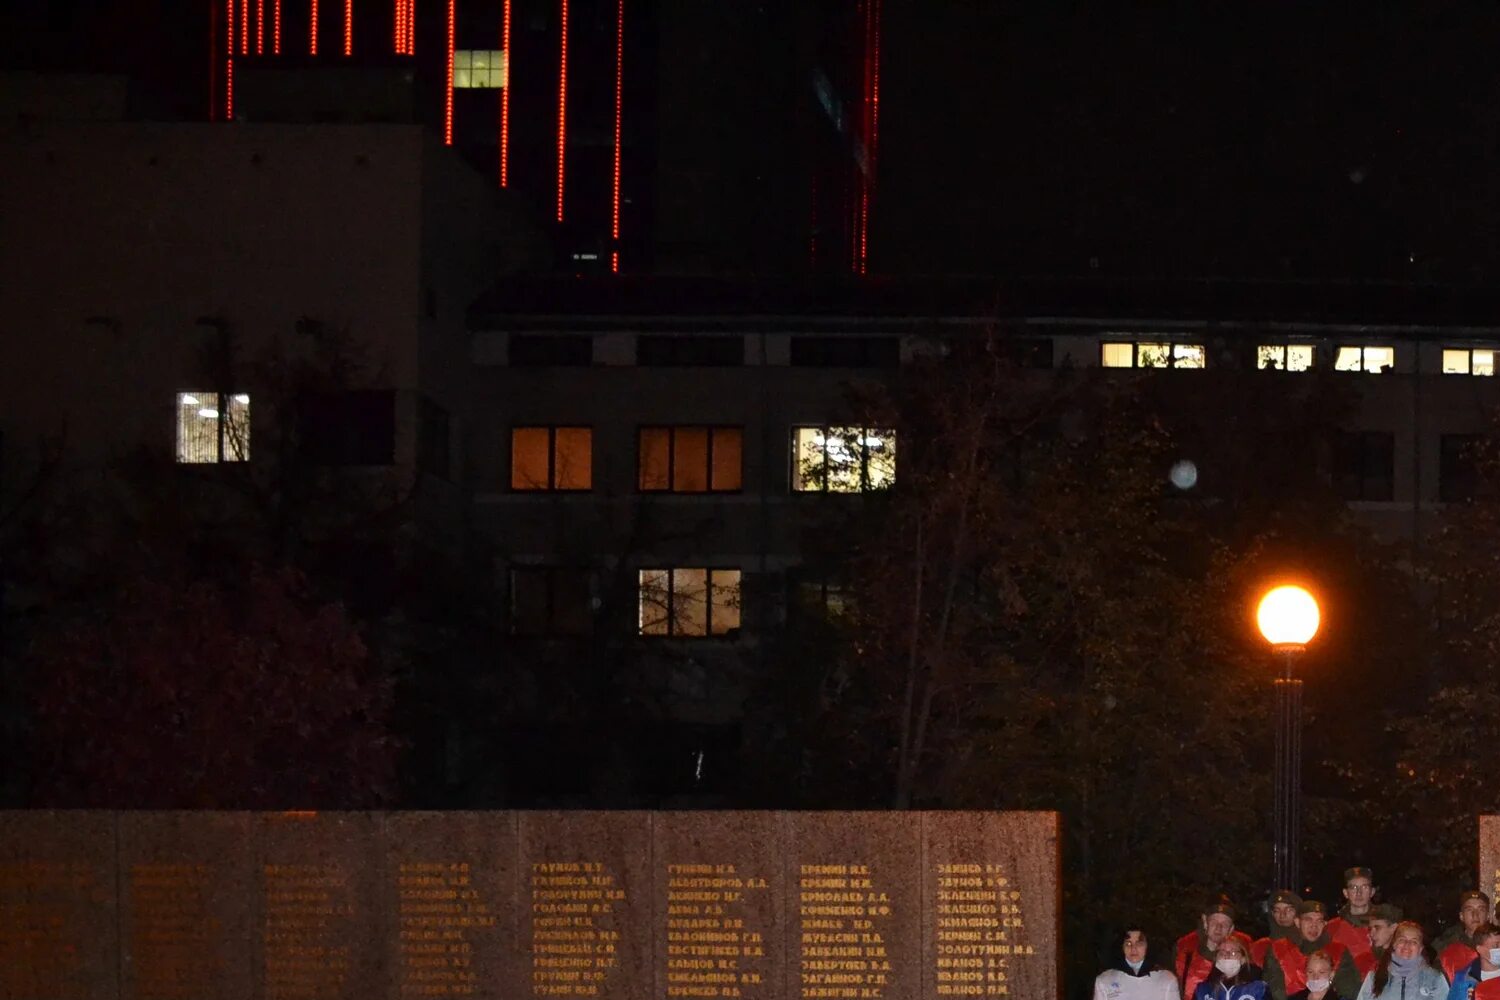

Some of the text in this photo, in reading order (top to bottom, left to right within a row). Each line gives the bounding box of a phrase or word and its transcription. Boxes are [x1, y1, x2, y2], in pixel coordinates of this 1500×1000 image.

[800, 893, 863, 901] ЕРМОЛАЕВ
[938, 946, 1009, 955] ЗОЛОТУХИН
[937, 959, 983, 968] ИВАНОВ
[937, 972, 983, 981] ИВАНОВ
[937, 986, 983, 994] ИВАНОВ
